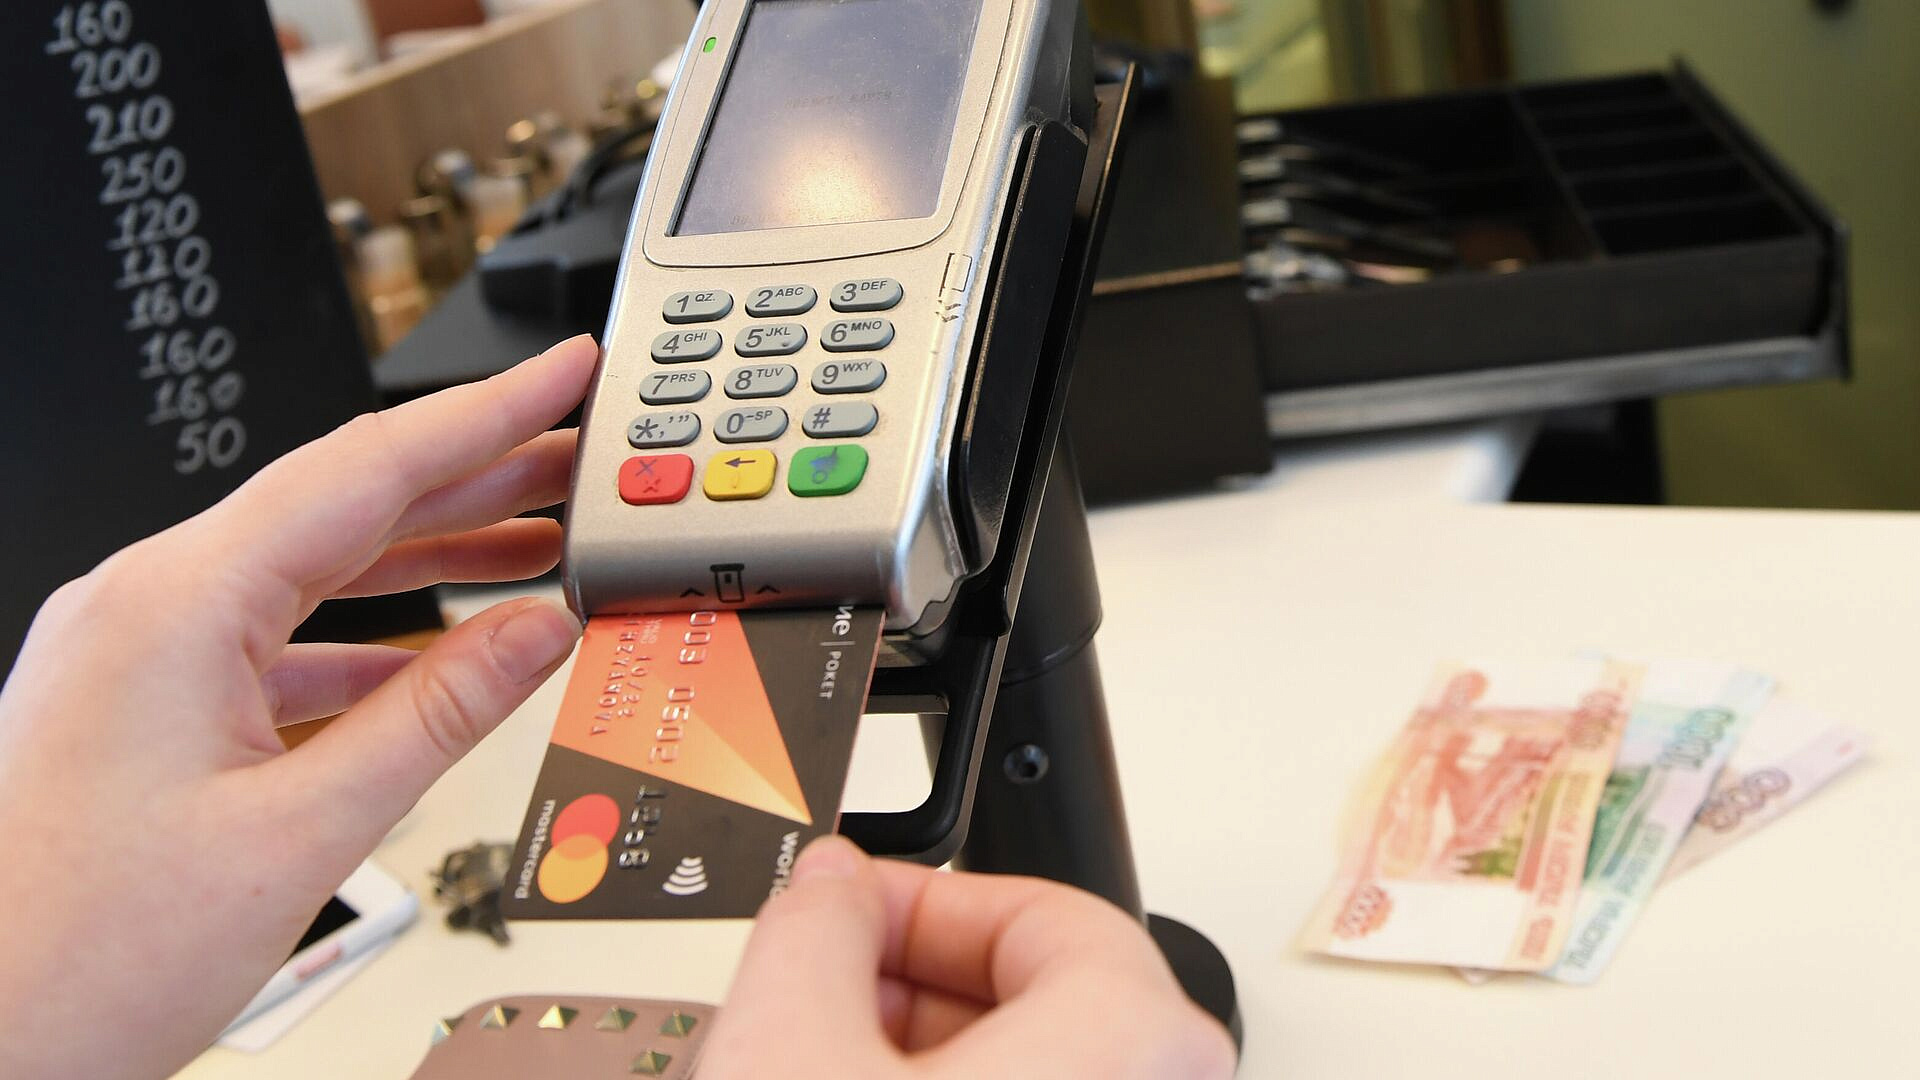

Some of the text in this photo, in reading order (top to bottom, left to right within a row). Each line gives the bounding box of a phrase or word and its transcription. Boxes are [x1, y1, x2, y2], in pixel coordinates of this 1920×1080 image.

[45, 0, 132, 54] 160
[71, 43, 161, 98] 200
[85, 96, 173, 154] 210
[100, 147, 186, 204] 250
[106, 193, 199, 250] 120
[125, 274, 219, 331] 160
[677, 295, 689, 313] 1
[755, 286, 804, 308] 2 ABC
[840, 280, 888, 301] 3 DEF
[662, 332, 707, 353] 4 GHI
[746, 326, 791, 348] 5 JKL
[830, 320, 882, 342] 6 MNO
[139, 326, 236, 380] 160
[652, 372, 696, 395] 7 PRS
[735, 367, 784, 390] 8 TUV
[822, 361, 873, 385] 9 WXY
[147, 371, 246, 426] 160
[726, 413, 744, 434] 0
[174, 416, 247, 474] 50
[514, 799, 556, 899] mastercard
